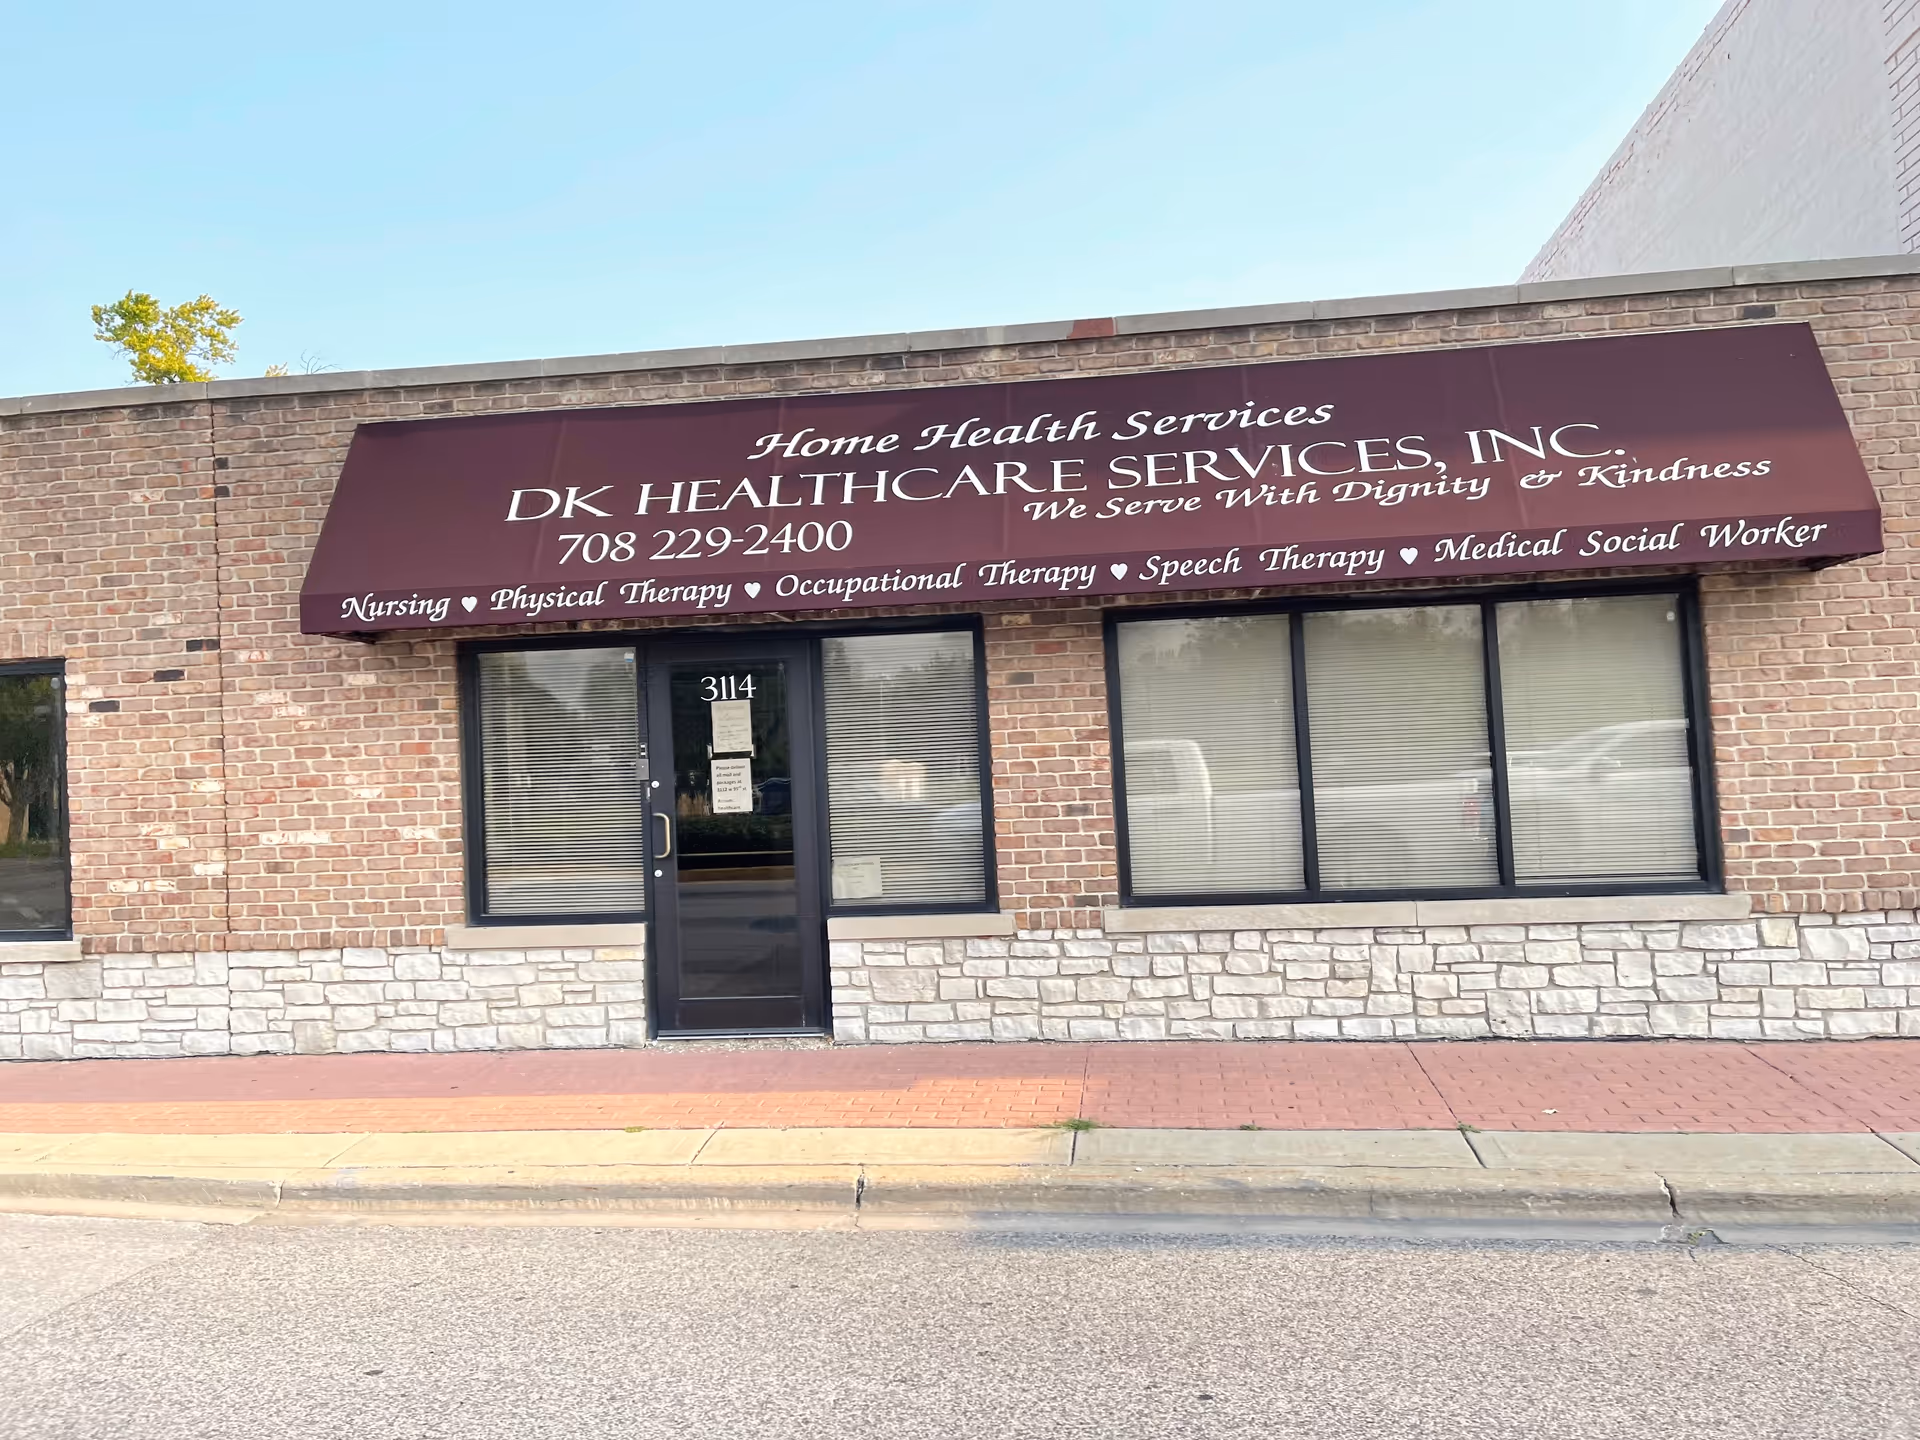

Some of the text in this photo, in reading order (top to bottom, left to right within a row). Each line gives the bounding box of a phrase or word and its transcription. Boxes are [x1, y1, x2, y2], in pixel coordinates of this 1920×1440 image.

[746, 400, 1335, 460] Home Health Services
[503, 423, 1626, 522] DK HEALTHCARE SERVICES, INC.
[1022, 457, 1772, 521] We Serve With Dignity & Kindness
[340, 516, 1828, 622] Nursing Physical Therapy Occupational Therapy Speech Therapy Medical Social Worker
[557, 520, 853, 565] 708 229-2400
[700, 673, 757, 701] 3114
